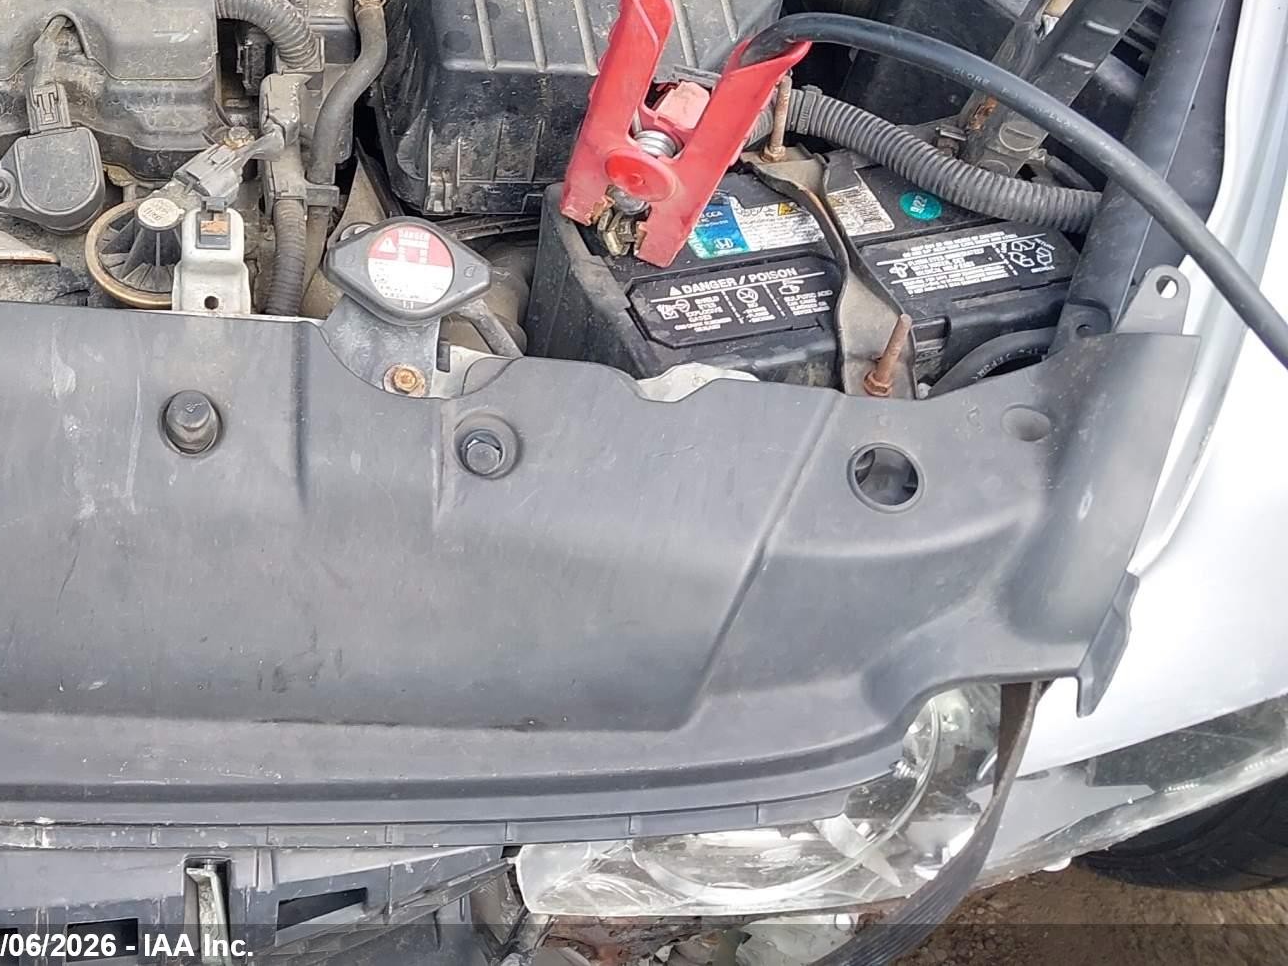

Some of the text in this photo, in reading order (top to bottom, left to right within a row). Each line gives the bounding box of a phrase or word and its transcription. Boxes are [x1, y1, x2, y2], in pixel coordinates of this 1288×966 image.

[681, 267, 798, 295] DANGER / POISON
